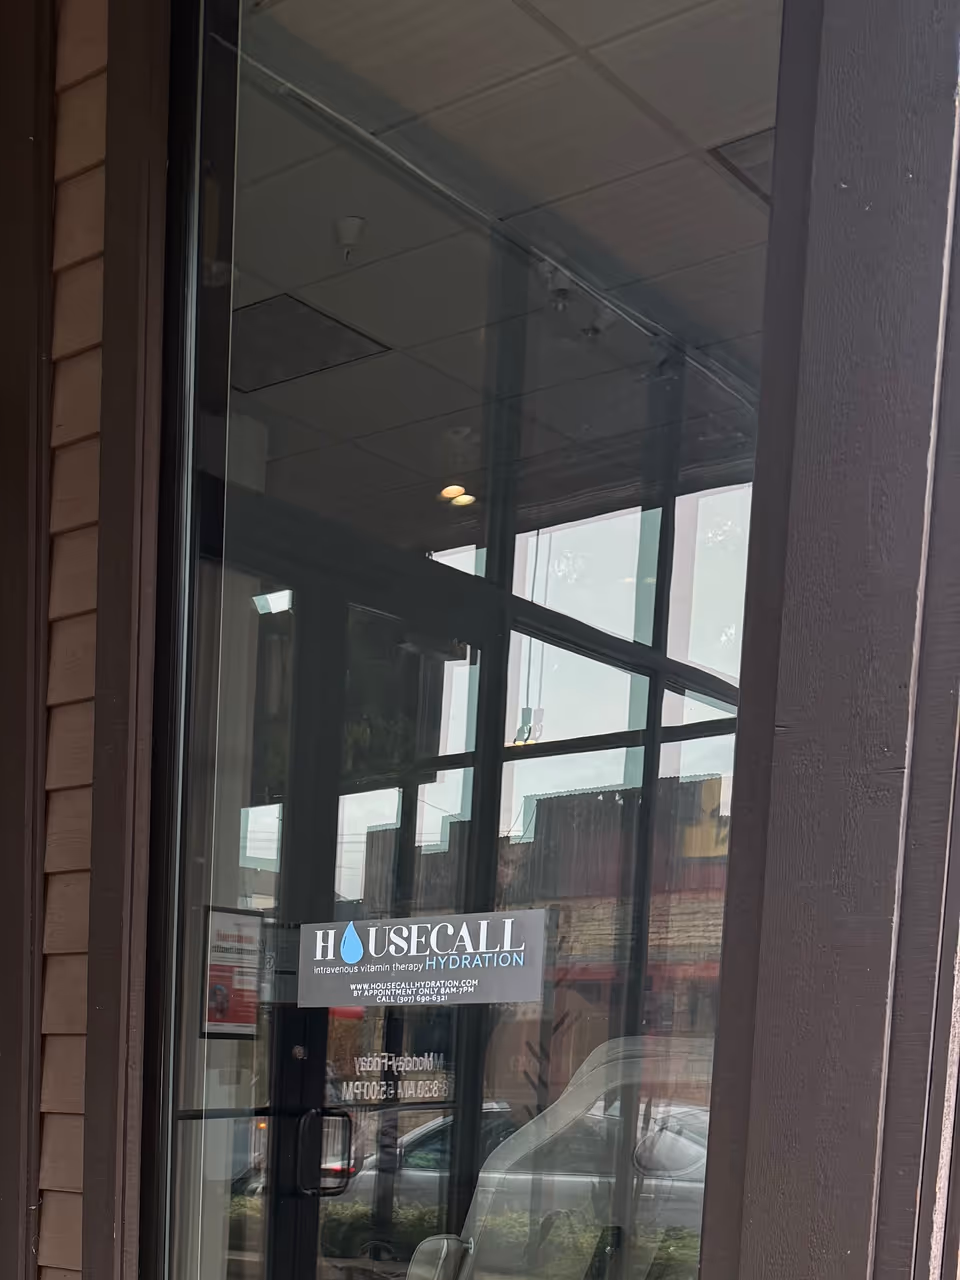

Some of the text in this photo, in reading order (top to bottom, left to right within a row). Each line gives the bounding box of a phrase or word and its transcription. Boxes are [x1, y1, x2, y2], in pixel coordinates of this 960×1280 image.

[425, 952, 525, 970] HYDRATION
[313, 962, 424, 974] intravenous vitamin therapy
[350, 979, 478, 990] WWW.HOUSECALLHYDRATION.COM
[364, 988, 416, 996] APPOINTMENT
[418, 987, 439, 995] ONLY
[440, 986, 474, 995] 8AM-7PM
[376, 995, 448, 1003] CALL (307) 690-6321
